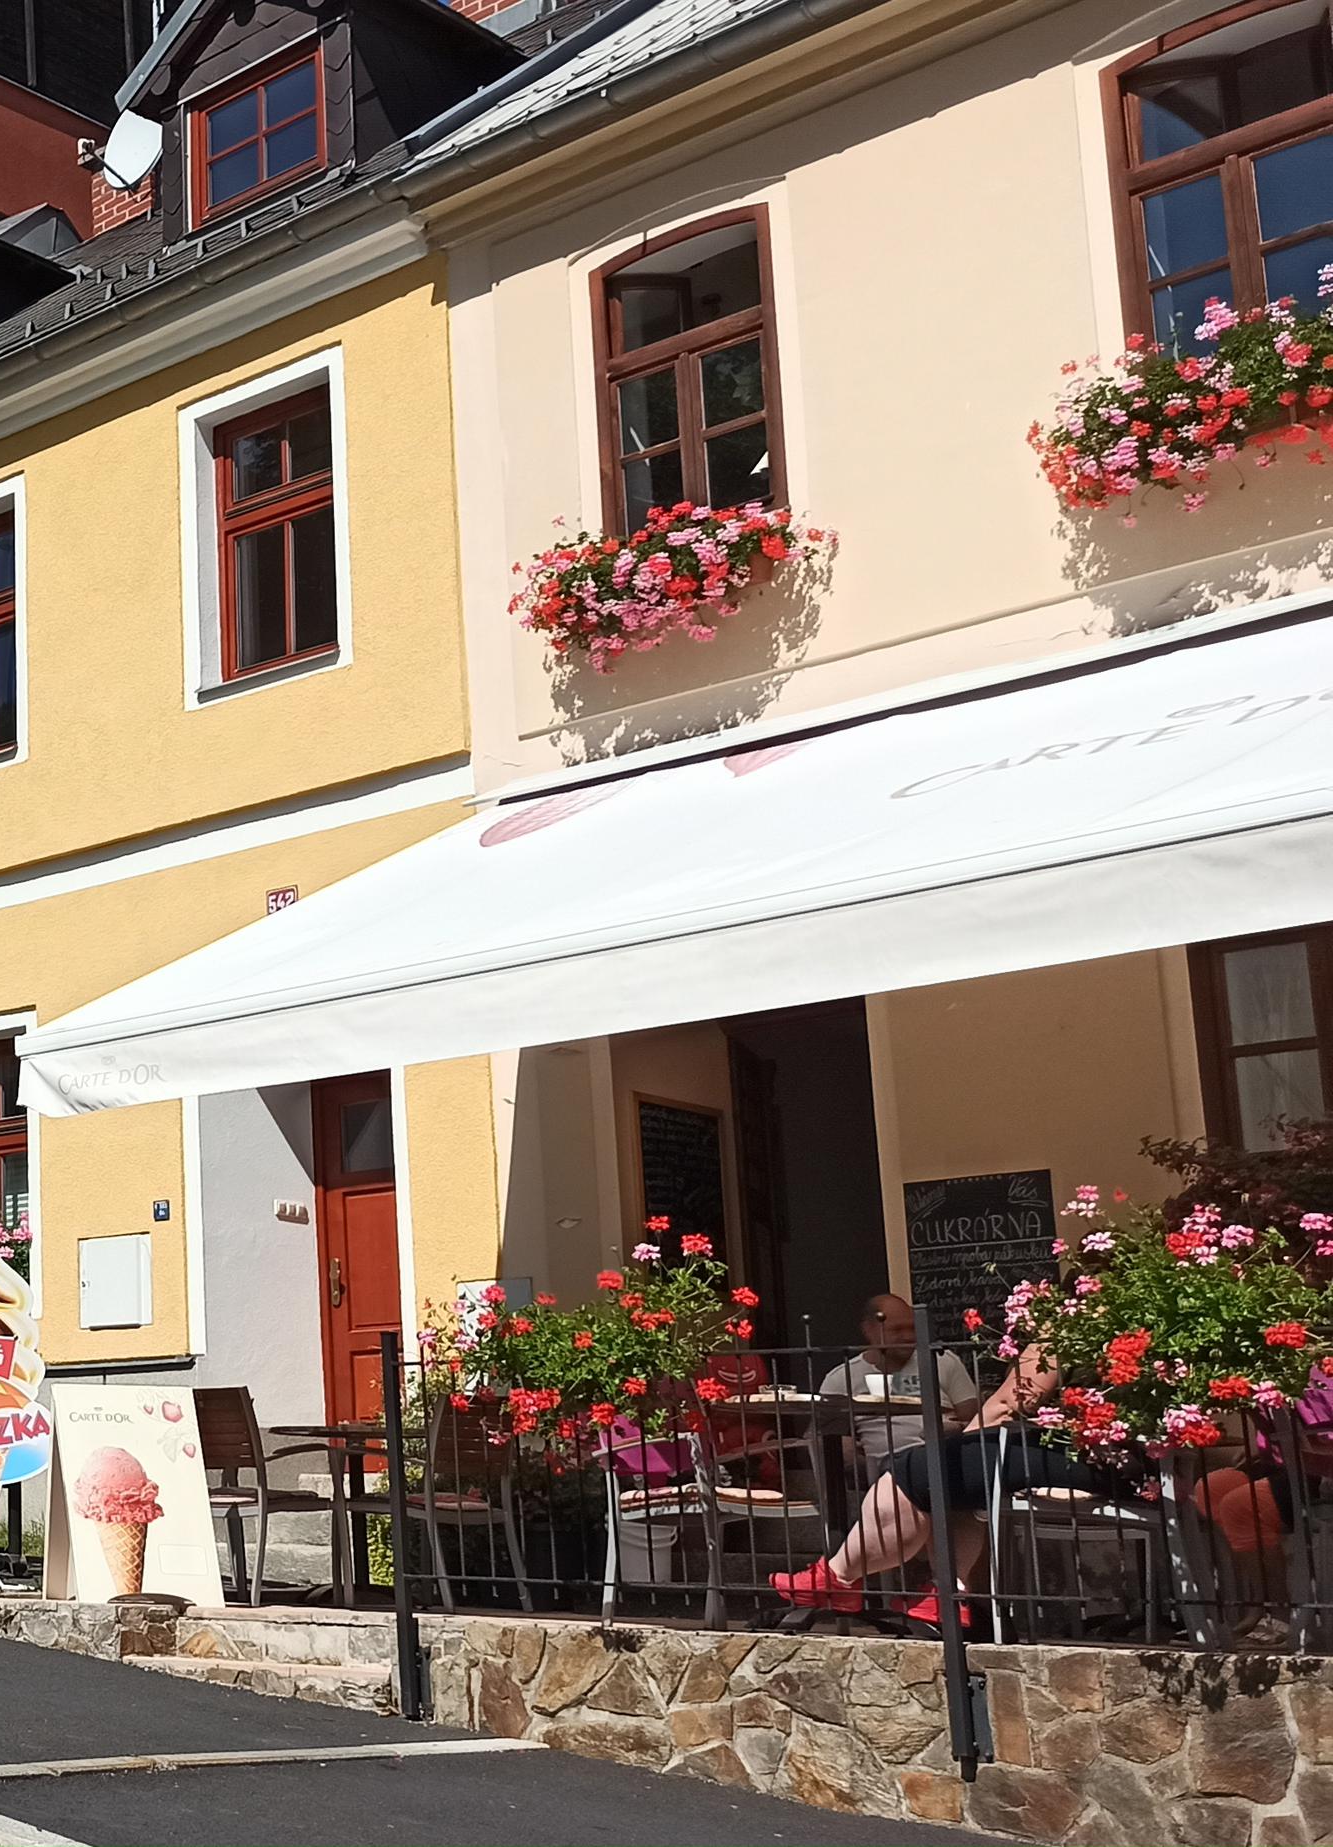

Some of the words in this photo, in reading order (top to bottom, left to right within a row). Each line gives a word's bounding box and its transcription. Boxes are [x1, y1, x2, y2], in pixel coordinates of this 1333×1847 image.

[890, 719, 1206, 799] CARTE
[269, 891, 294, 914] 542
[58, 1071, 112, 1095] CARTE
[911, 1208, 1041, 1246] CUKRÁRNA
[69, 1412, 101, 1422] CARTE
